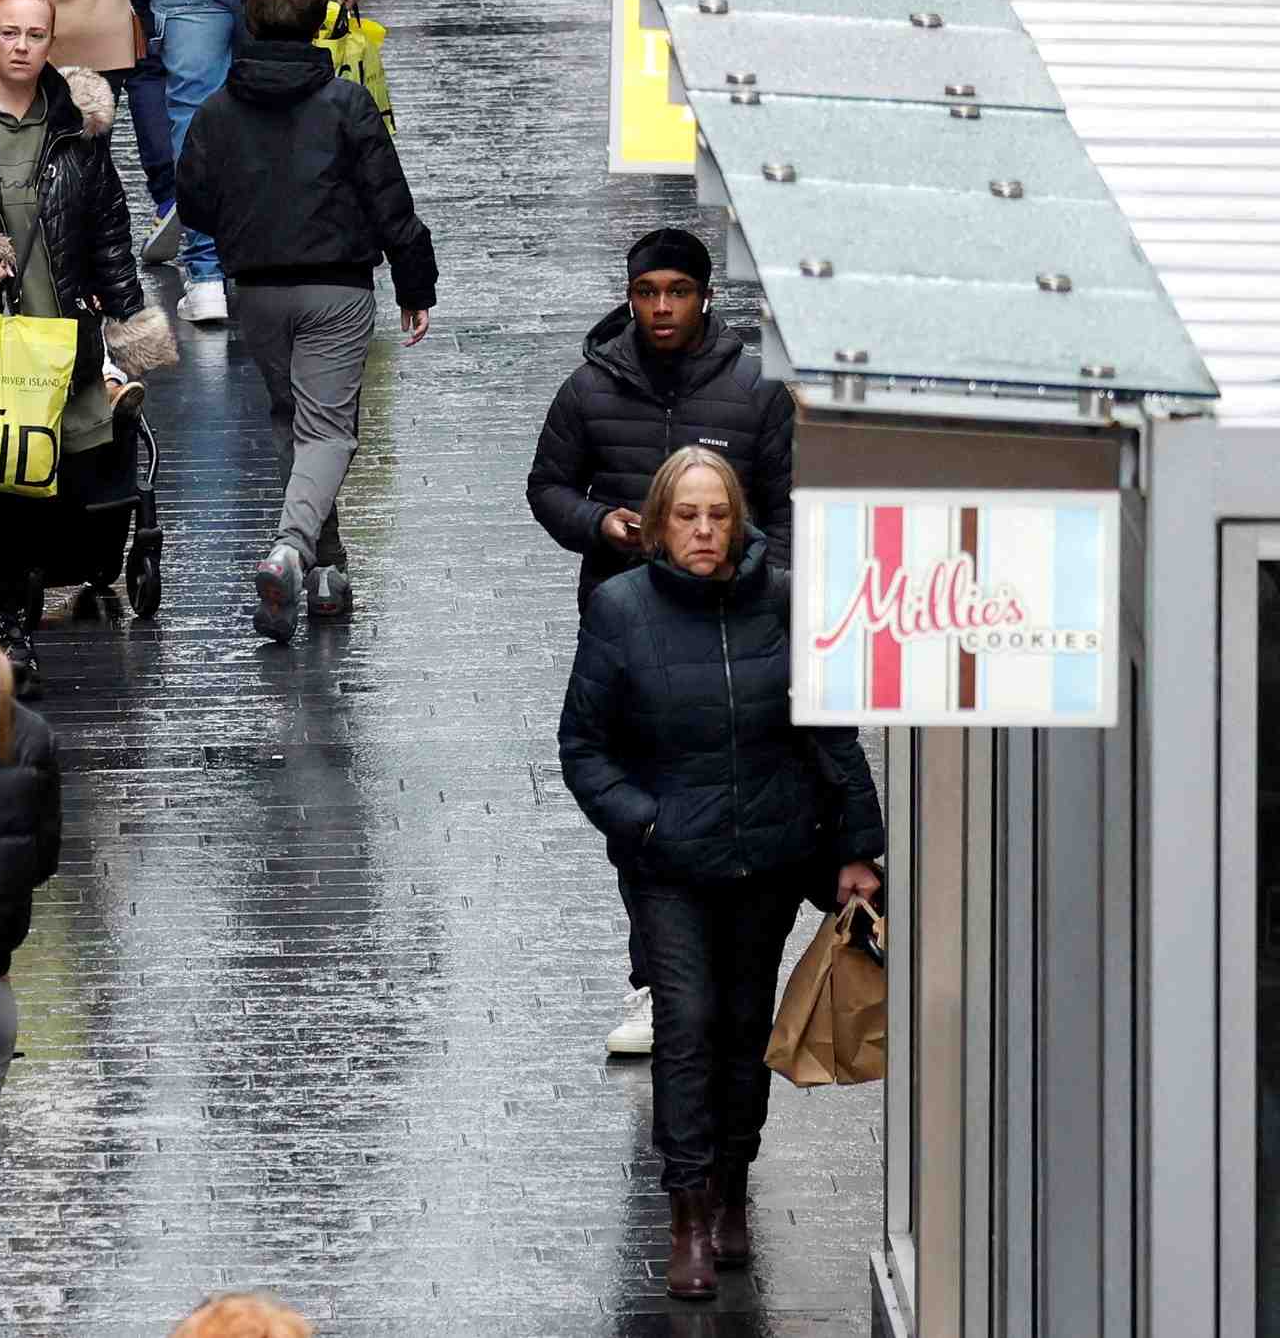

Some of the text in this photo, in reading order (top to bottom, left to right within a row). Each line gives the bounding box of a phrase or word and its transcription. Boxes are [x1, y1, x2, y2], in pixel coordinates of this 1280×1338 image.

[1, 375, 61, 388] RIVER ISLAND
[815, 560, 1024, 649] Millie's
[966, 632, 1099, 648] COOKIES
